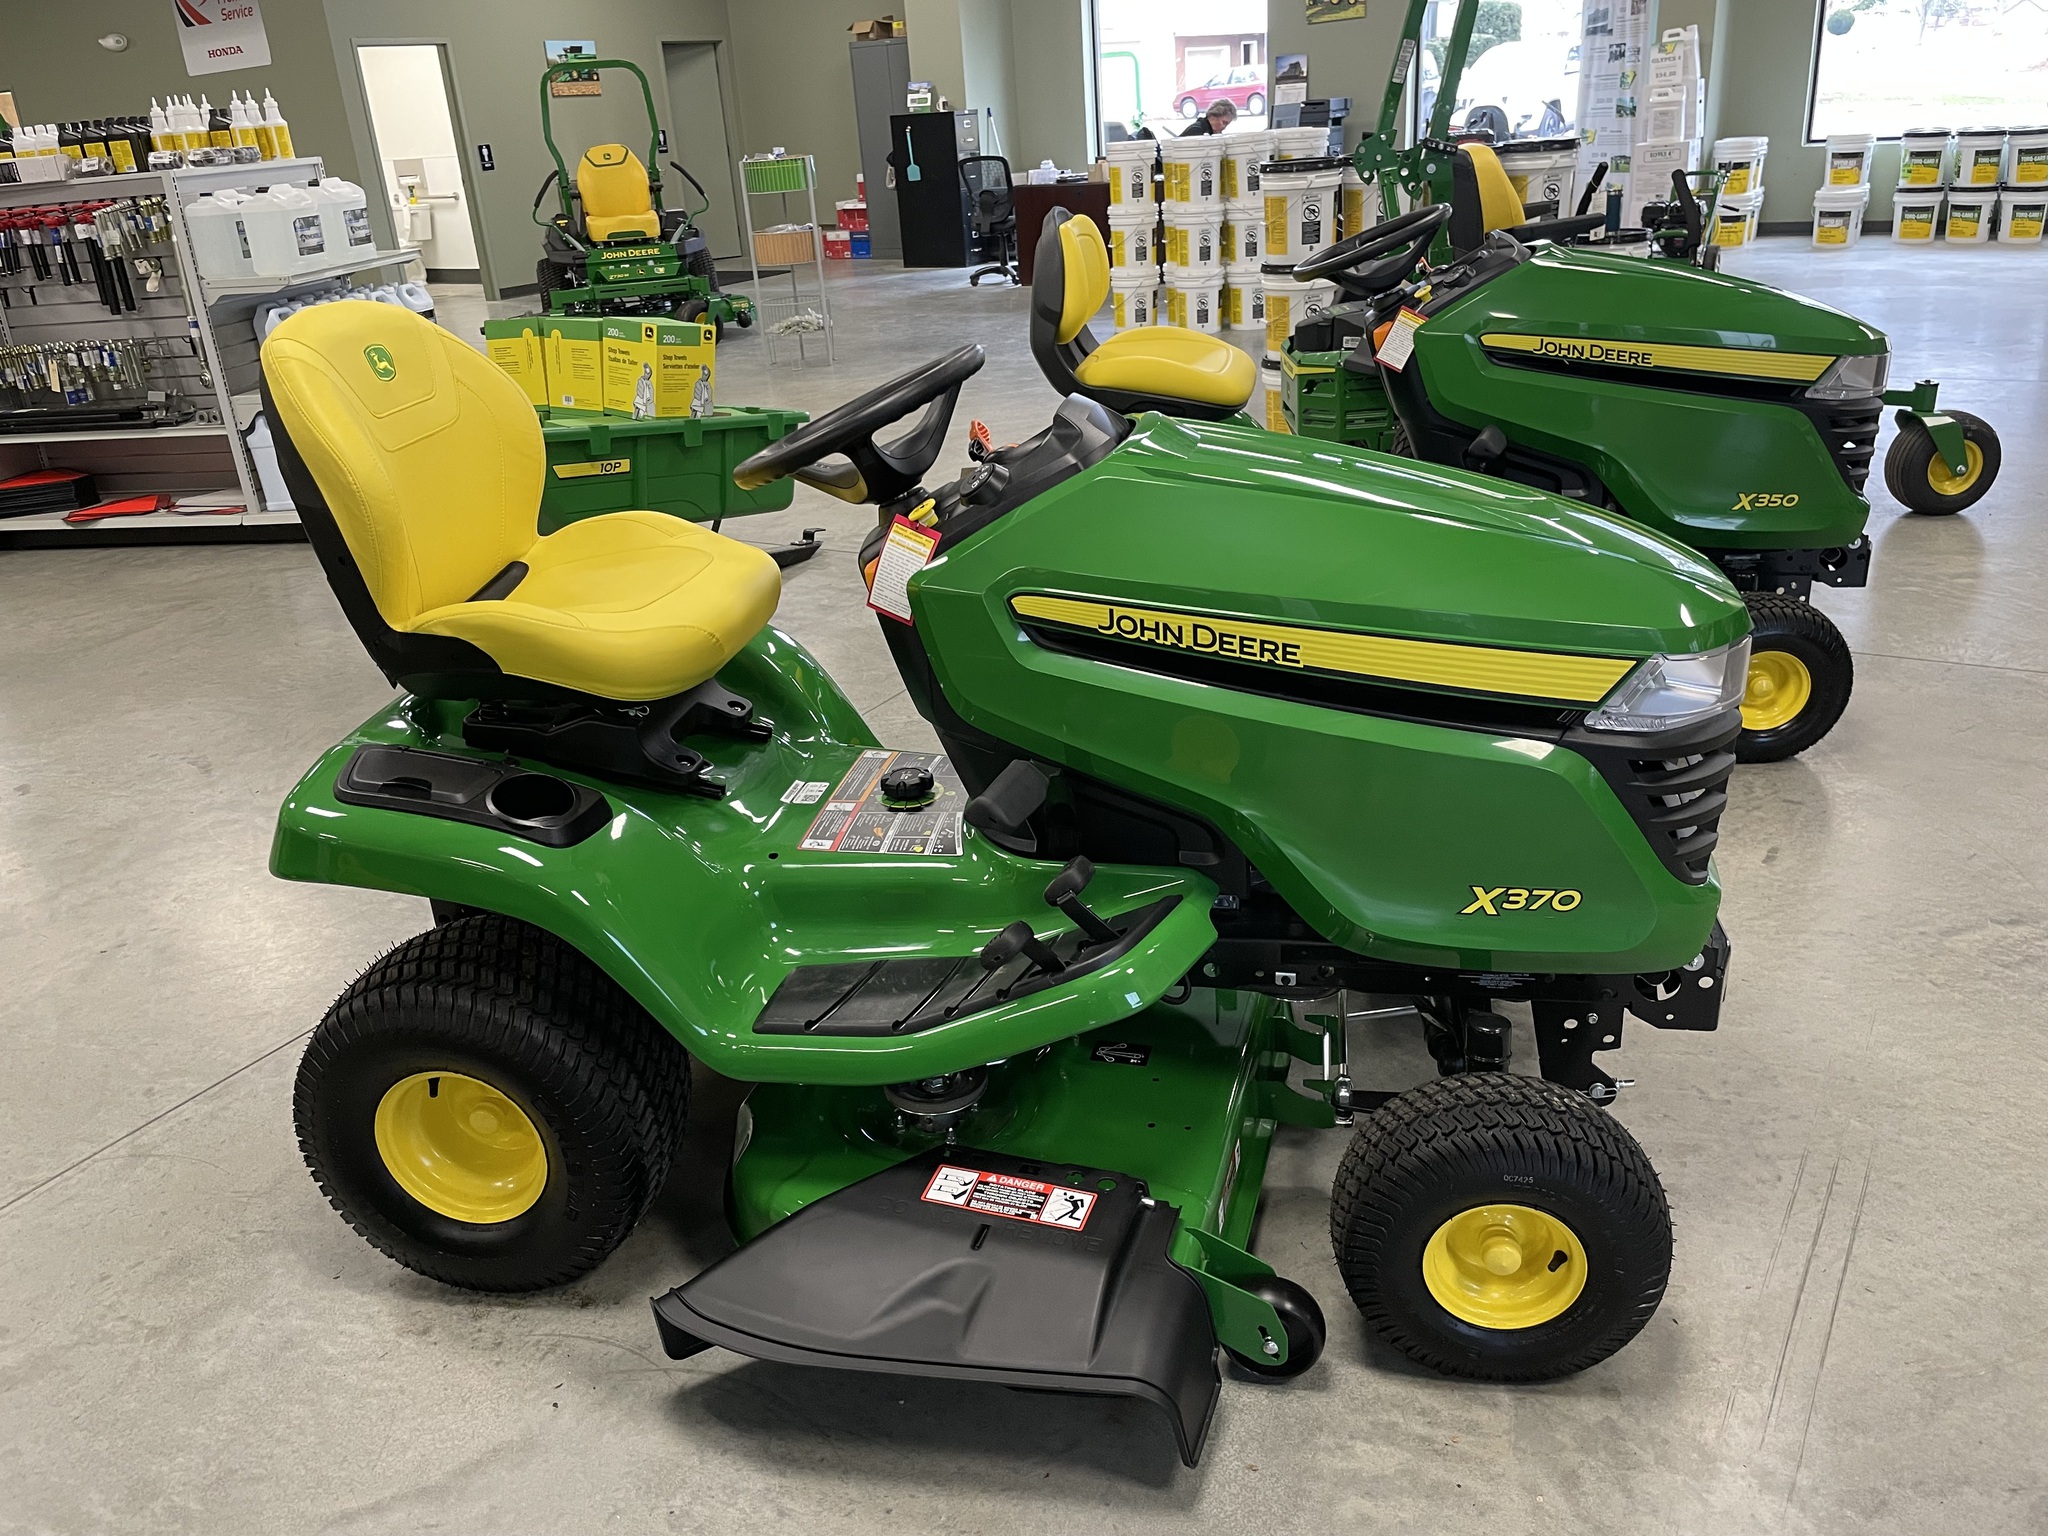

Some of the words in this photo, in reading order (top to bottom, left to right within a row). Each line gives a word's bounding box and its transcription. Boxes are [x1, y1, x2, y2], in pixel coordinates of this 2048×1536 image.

[220, 4, 254, 21] Service
[208, 46, 244, 58] HONDA
[601, 250, 627, 260] JOHN
[627, 248, 660, 258] DEERE
[608, 328, 618, 336] 200
[663, 335, 675, 343] 200
[1532, 338, 1585, 358] JOHN
[1589, 344, 1653, 366] DEERE
[600, 461, 621, 473] 10P
[1732, 492, 1800, 512] X350
[1098, 607, 1185, 646] JOHN
[1190, 624, 1302, 666] DEERE
[1458, 886, 1582, 916] X370
[999, 1176, 1045, 1191] DANGER
